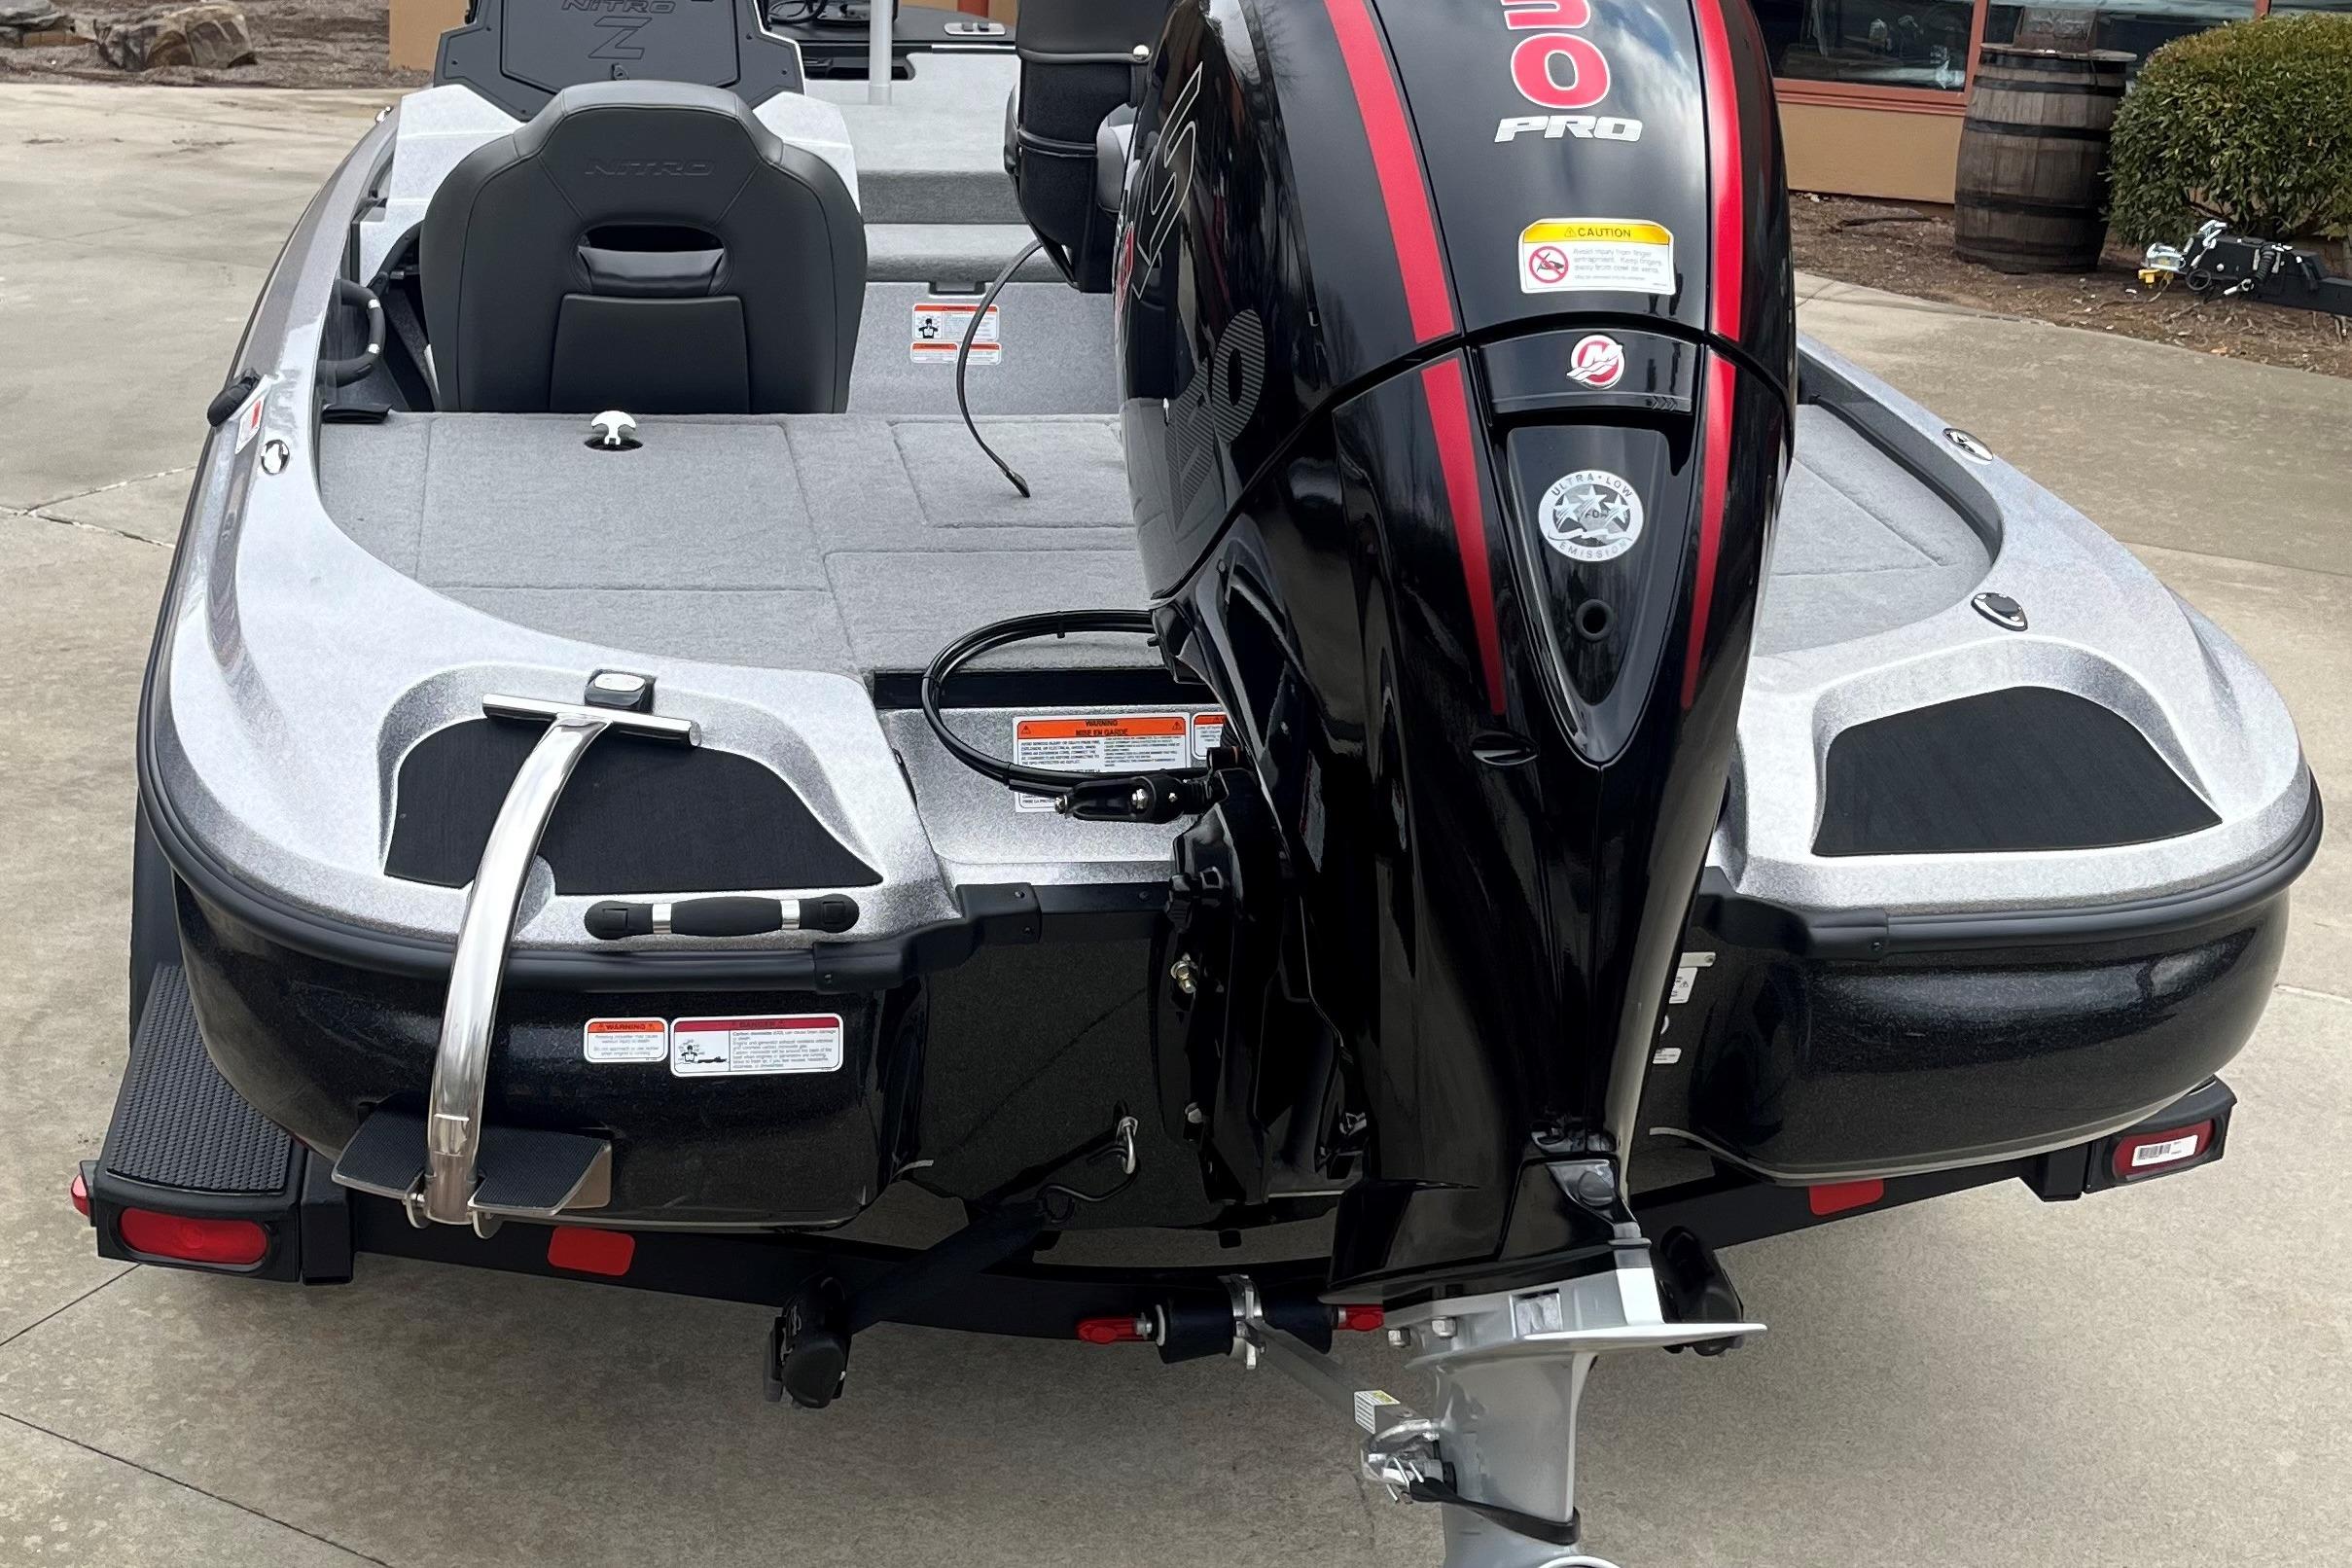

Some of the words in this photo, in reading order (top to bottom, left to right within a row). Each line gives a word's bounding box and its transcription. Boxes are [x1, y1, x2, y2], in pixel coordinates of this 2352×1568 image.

[561, 0, 676, 14] NITRO
[588, 16, 653, 59] Z
[1494, 115, 1643, 143] PRO
[584, 159, 716, 176] NITRO
[1578, 228, 1631, 238] CAUTION
[1550, 473, 1594, 497] ULTRA
[1605, 476, 1633, 498] LOW
[1559, 541, 1628, 559] EMISSION
